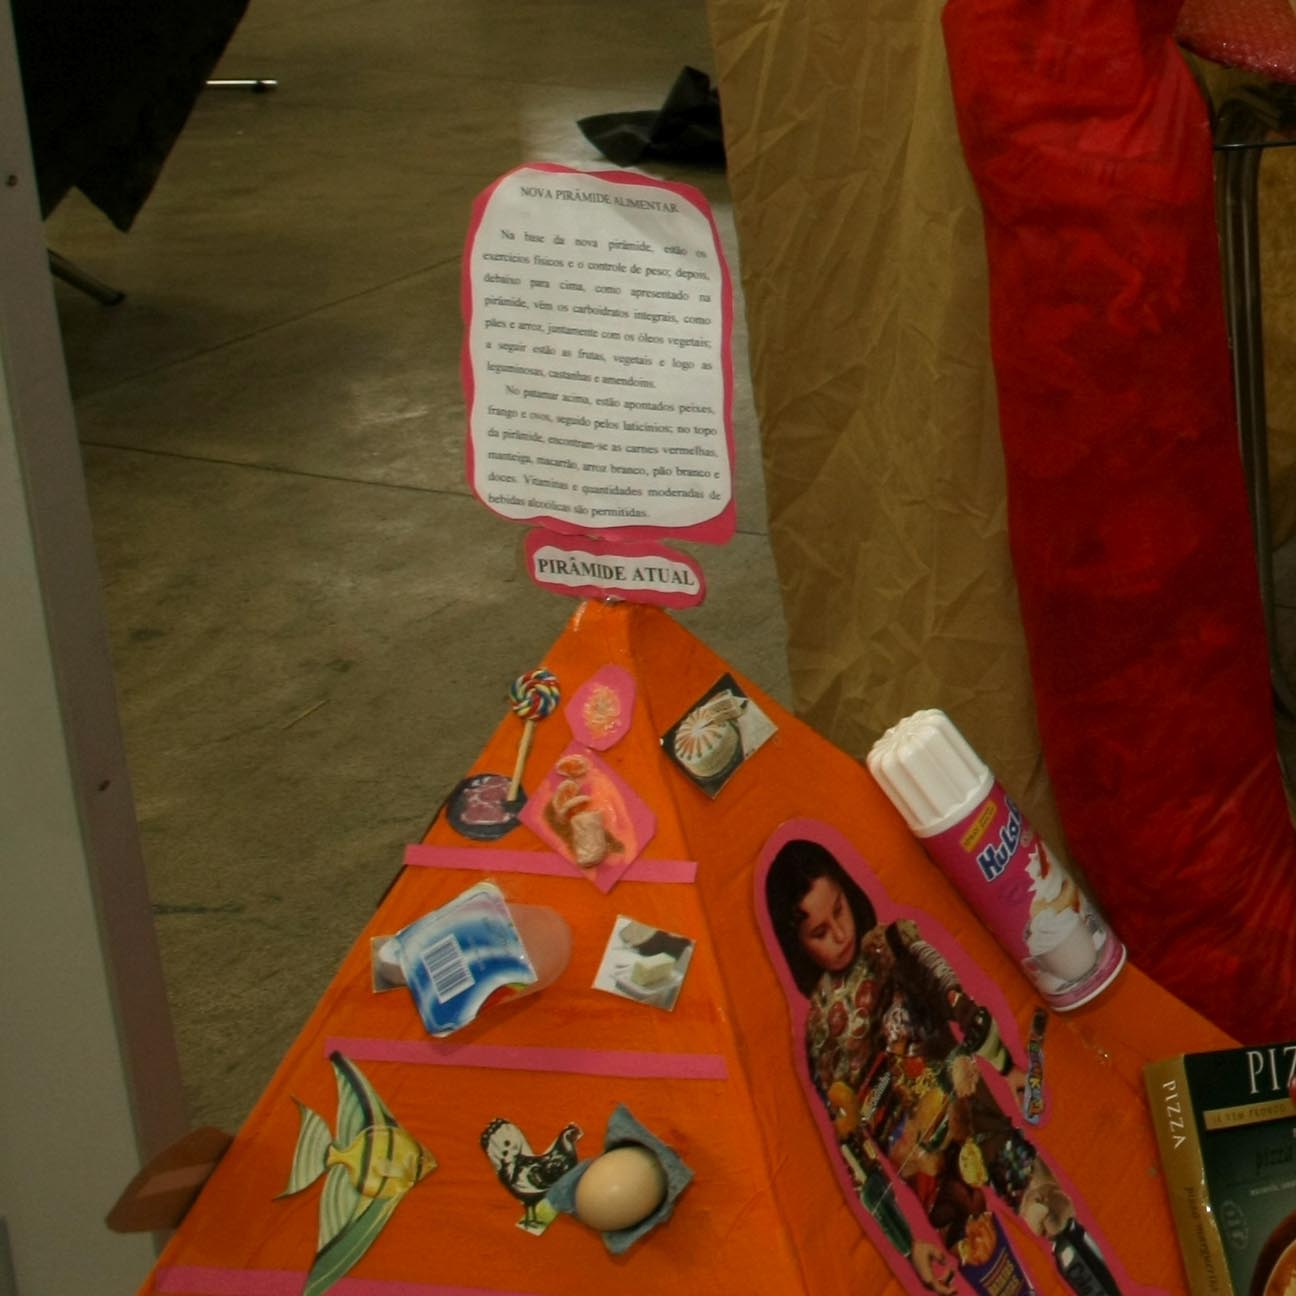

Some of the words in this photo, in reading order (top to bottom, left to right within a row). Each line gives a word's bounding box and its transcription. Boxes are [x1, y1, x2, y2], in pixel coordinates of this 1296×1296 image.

[538, 557, 626, 581] PIRÂMIDE
[634, 565, 695, 586] ATUAL
[1162, 1079, 1187, 1149] PIZZA
